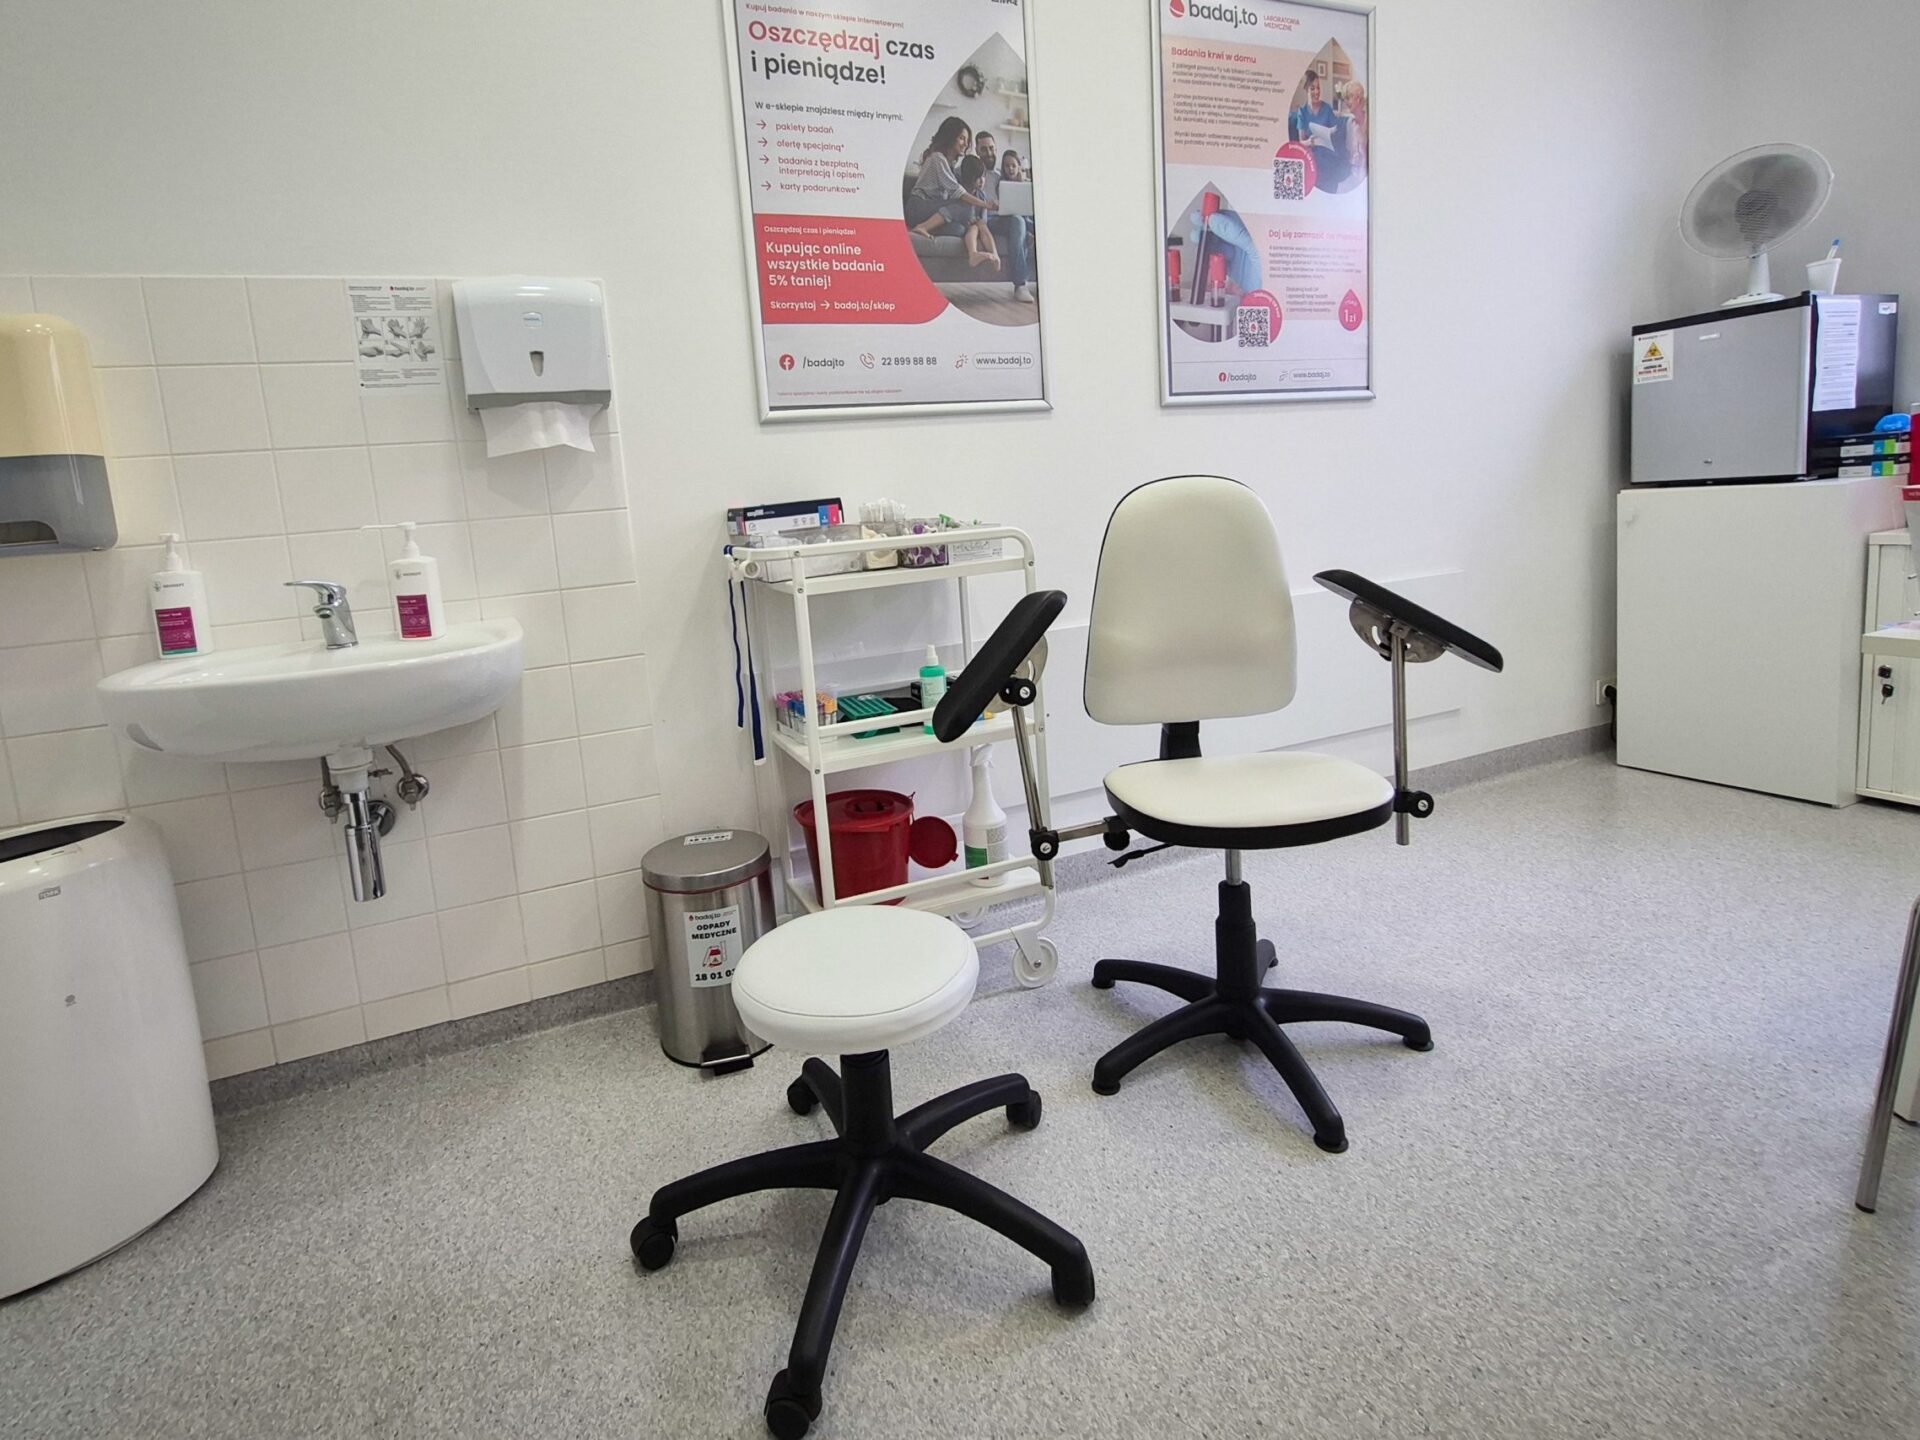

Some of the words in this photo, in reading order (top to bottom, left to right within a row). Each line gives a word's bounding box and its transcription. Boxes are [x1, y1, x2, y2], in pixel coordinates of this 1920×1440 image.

[746, 3, 766, 13] Kupuj
[768, 5, 797, 15] badania
[833, 13, 856, 23] sklepie
[1188, 0, 1258, 28] badaj.to
[749, 21, 880, 59] Oszczędzaj
[886, 40, 935, 60] czas
[1171, 46, 1206, 58] Badania
[1207, 50, 1224, 60] krwi
[1233, 53, 1257, 64] domu
[751, 50, 757, 72] i
[764, 52, 886, 85] pieniądze!
[766, 103, 804, 113] e-sklepie
[806, 105, 845, 117] znajdziesz
[846, 110, 874, 121] między
[876, 111, 904, 122] innymi:
[776, 122, 806, 133] pakiety
[807, 125, 834, 134] badań
[777, 139, 801, 150] ofertę
[778, 156, 812, 166] badania
[820, 159, 859, 170] bezpłatną
[779, 166, 830, 178] interpretacją
[837, 170, 865, 179] opisem
[780, 182, 801, 193] karty
[764, 225, 802, 235] Oszczędzaj
[765, 241, 820, 257] Kupując
[823, 243, 861, 255] online
[767, 259, 830, 273] wszystkie
[832, 259, 885, 272] badania
[769, 274, 788, 286] 5%
[791, 274, 831, 290] taniej!
[770, 300, 816, 311] Skorzystaj
[834, 300, 896, 312] badaj.to/sklep
[802, 357, 845, 369] /badajto
[881, 357, 892, 366] 22
[894, 357, 911, 366] 899
[913, 356, 924, 365] 88
[926, 356, 937, 365] 88
[975, 355, 1032, 367] www.badaj.to
[696, 920, 731, 931] ODPADY
[691, 927, 737, 940] MEDYCZNE
[695, 973, 707, 982] 18
[710, 971, 722, 980] 01
